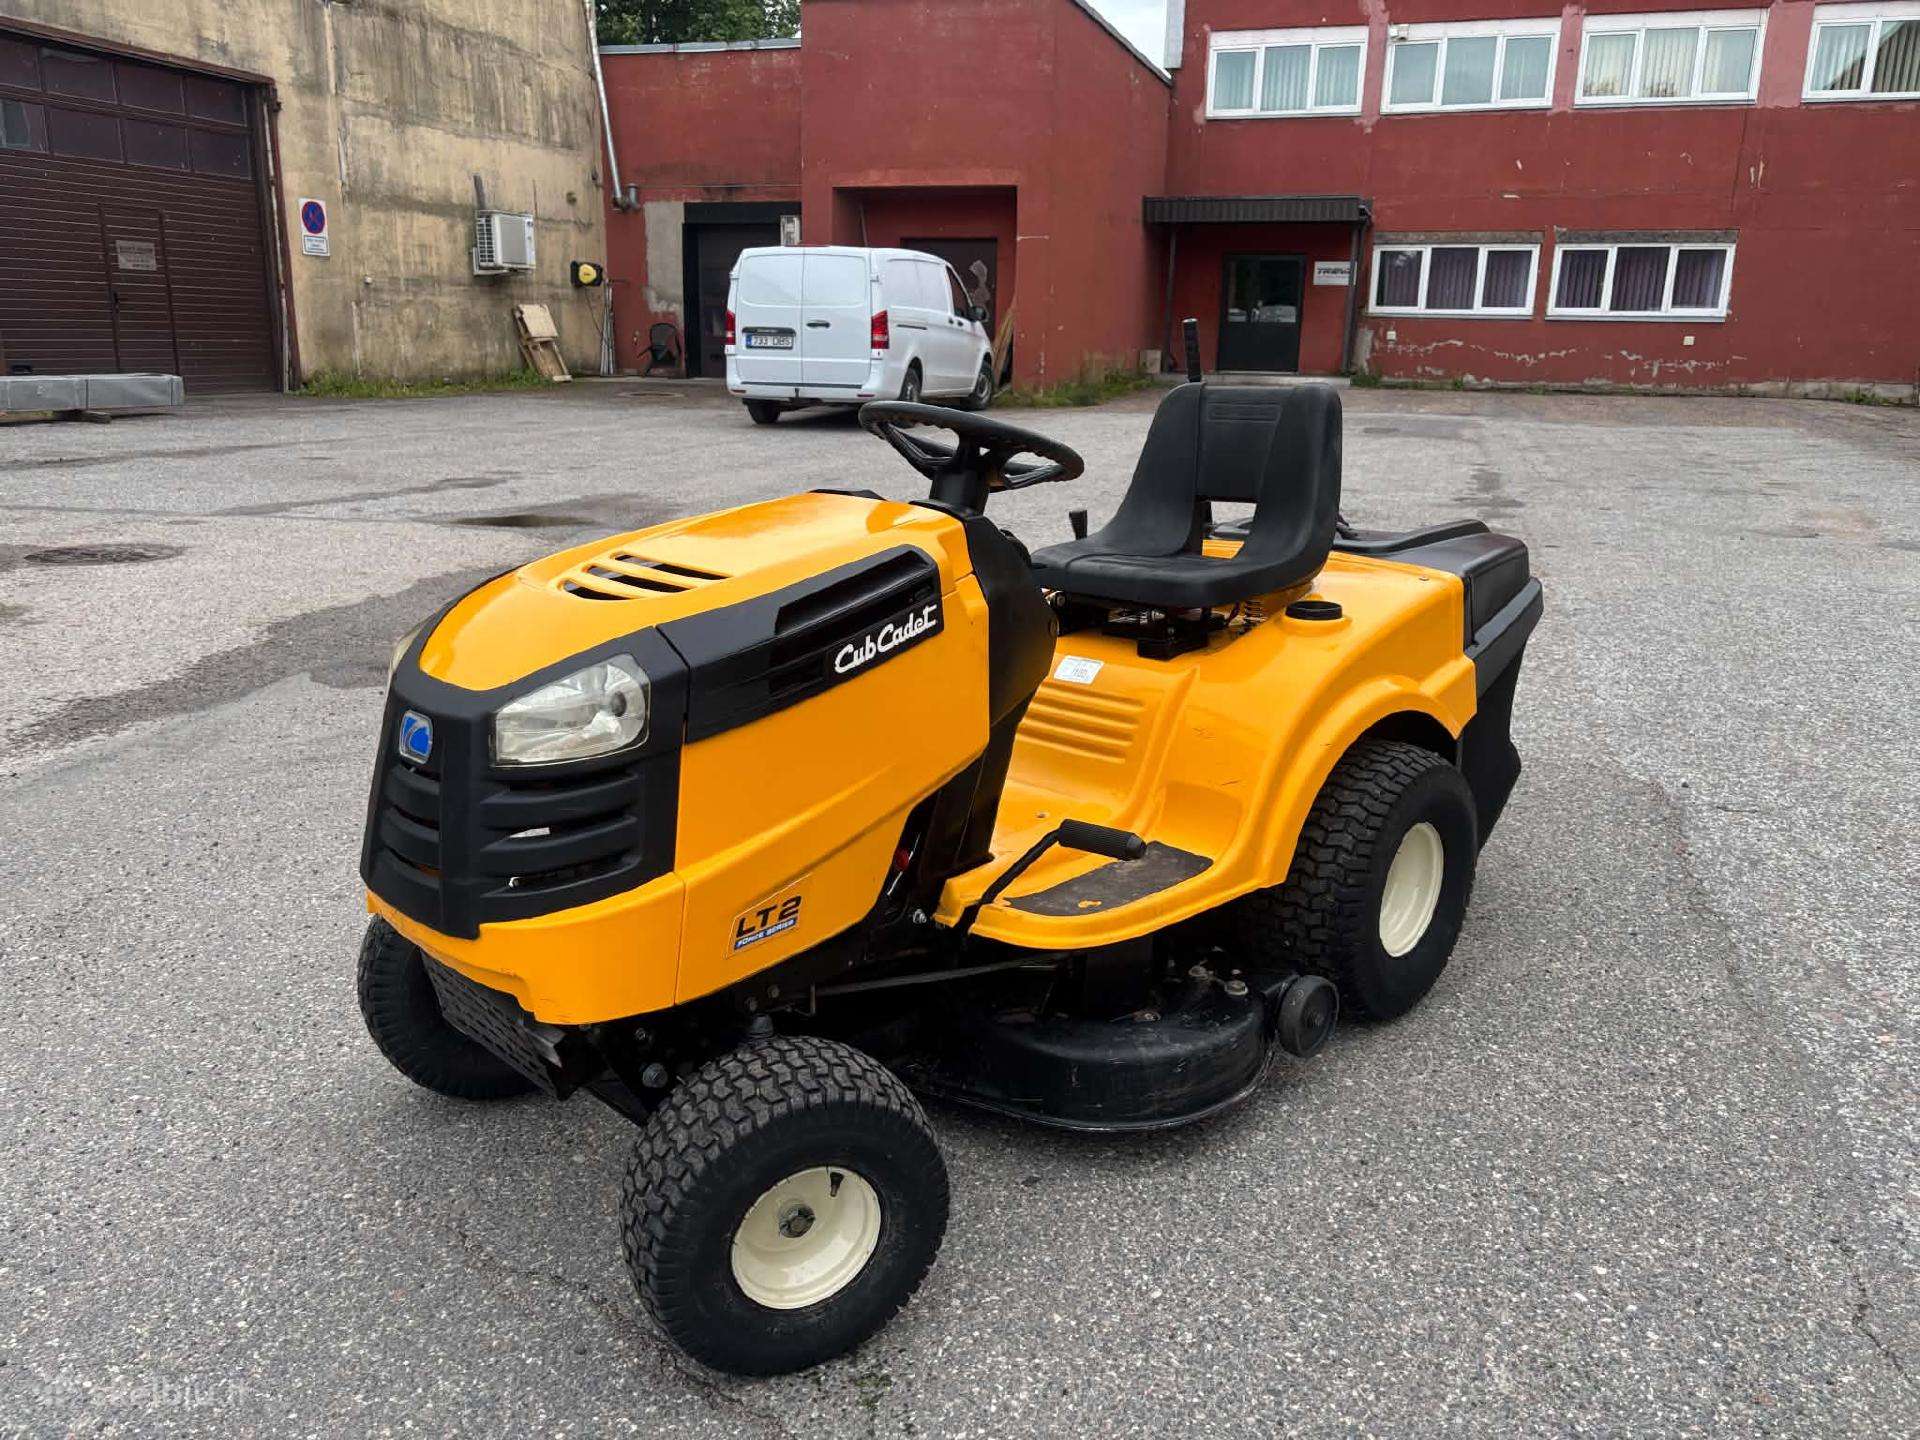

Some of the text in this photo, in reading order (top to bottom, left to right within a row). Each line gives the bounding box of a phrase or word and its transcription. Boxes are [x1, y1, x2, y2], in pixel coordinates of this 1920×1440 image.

[834, 604, 937, 674] Cub Cadet
[736, 895, 802, 938] LT2
